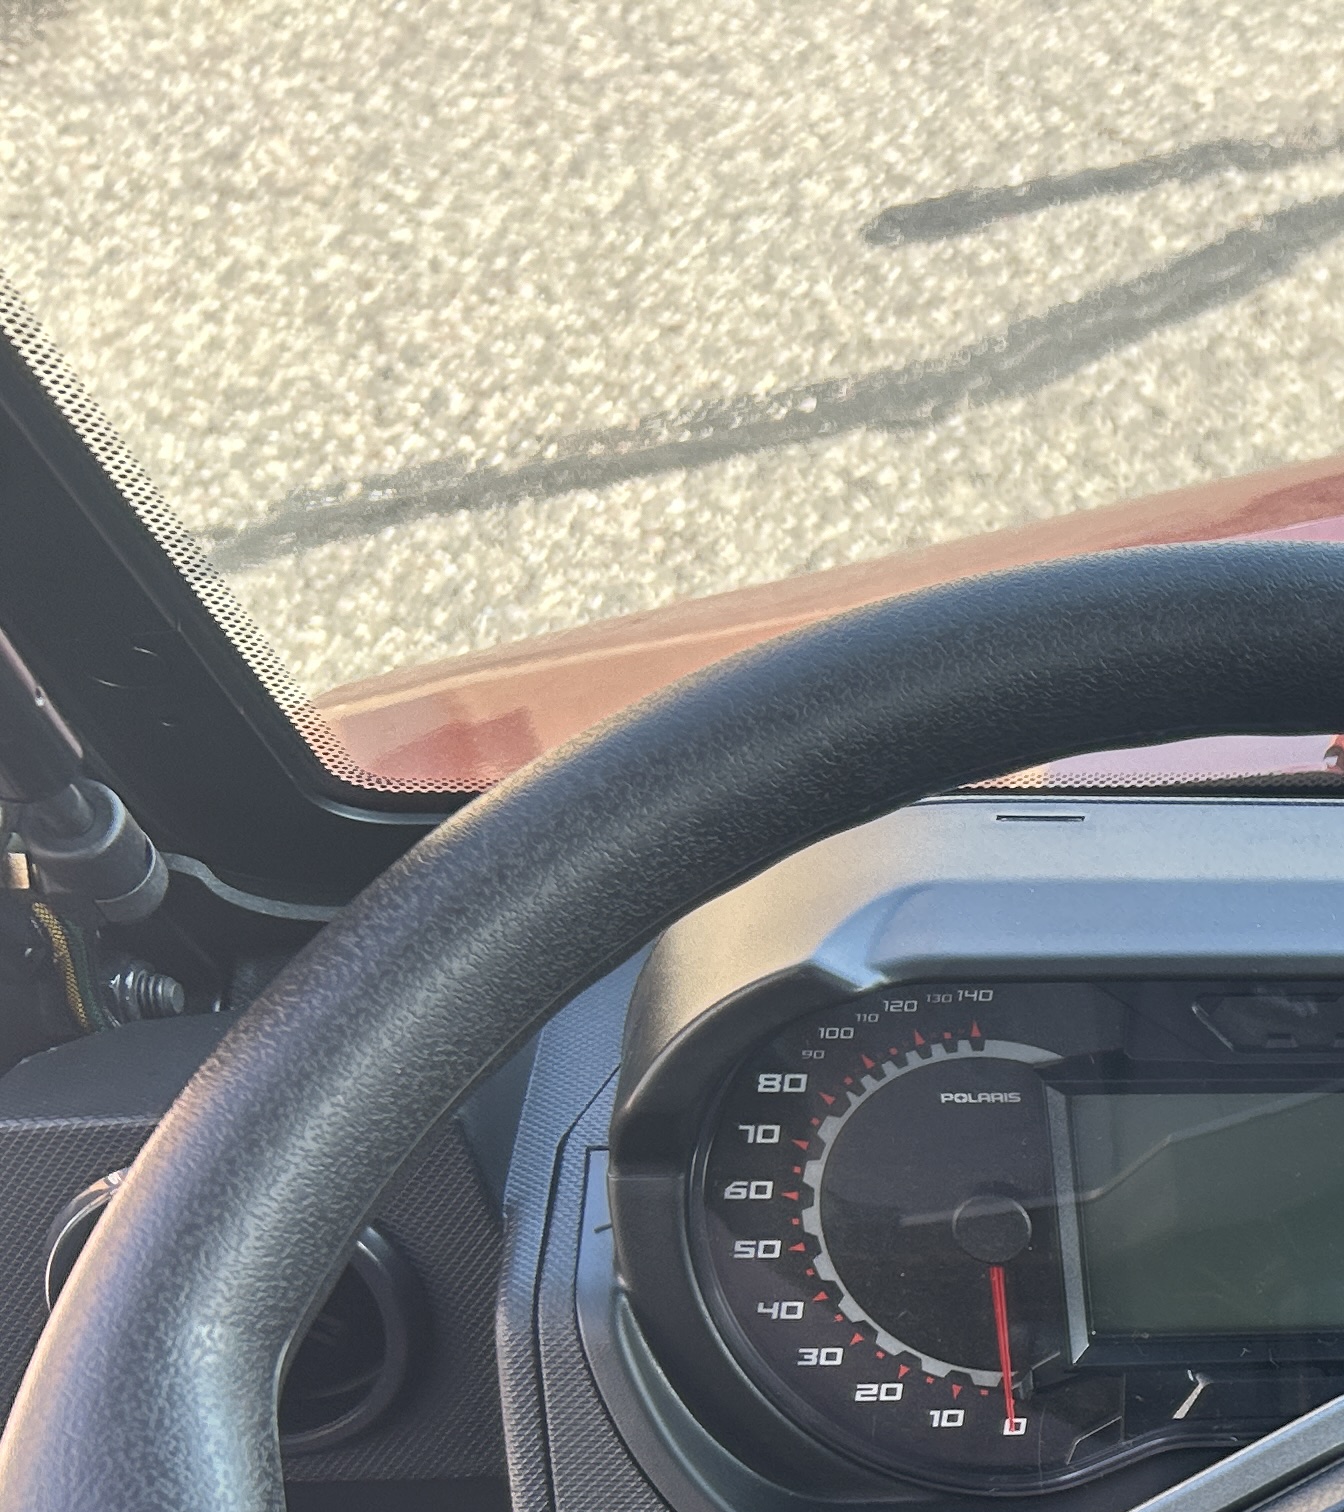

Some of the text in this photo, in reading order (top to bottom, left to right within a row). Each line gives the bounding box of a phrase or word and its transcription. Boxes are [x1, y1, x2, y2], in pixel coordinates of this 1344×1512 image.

[926, 993, 953, 1003] 130
[957, 988, 994, 1002] 140
[883, 999, 918, 1013] 120
[856, 1012, 880, 1023] 110
[818, 1026, 854, 1040] 100
[801, 1049, 825, 1060] 90
[757, 1072, 808, 1093] 80
[940, 1091, 1022, 1104] POLARIS
[738, 1124, 781, 1144] 70
[724, 1180, 773, 1201] 60
[733, 1239, 782, 1260] 50
[757, 1301, 804, 1321] 40
[797, 1346, 844, 1367] 30
[855, 1382, 904, 1402] 20
[929, 1407, 965, 1429] 10
[1003, 1416, 1028, 1436] 0
